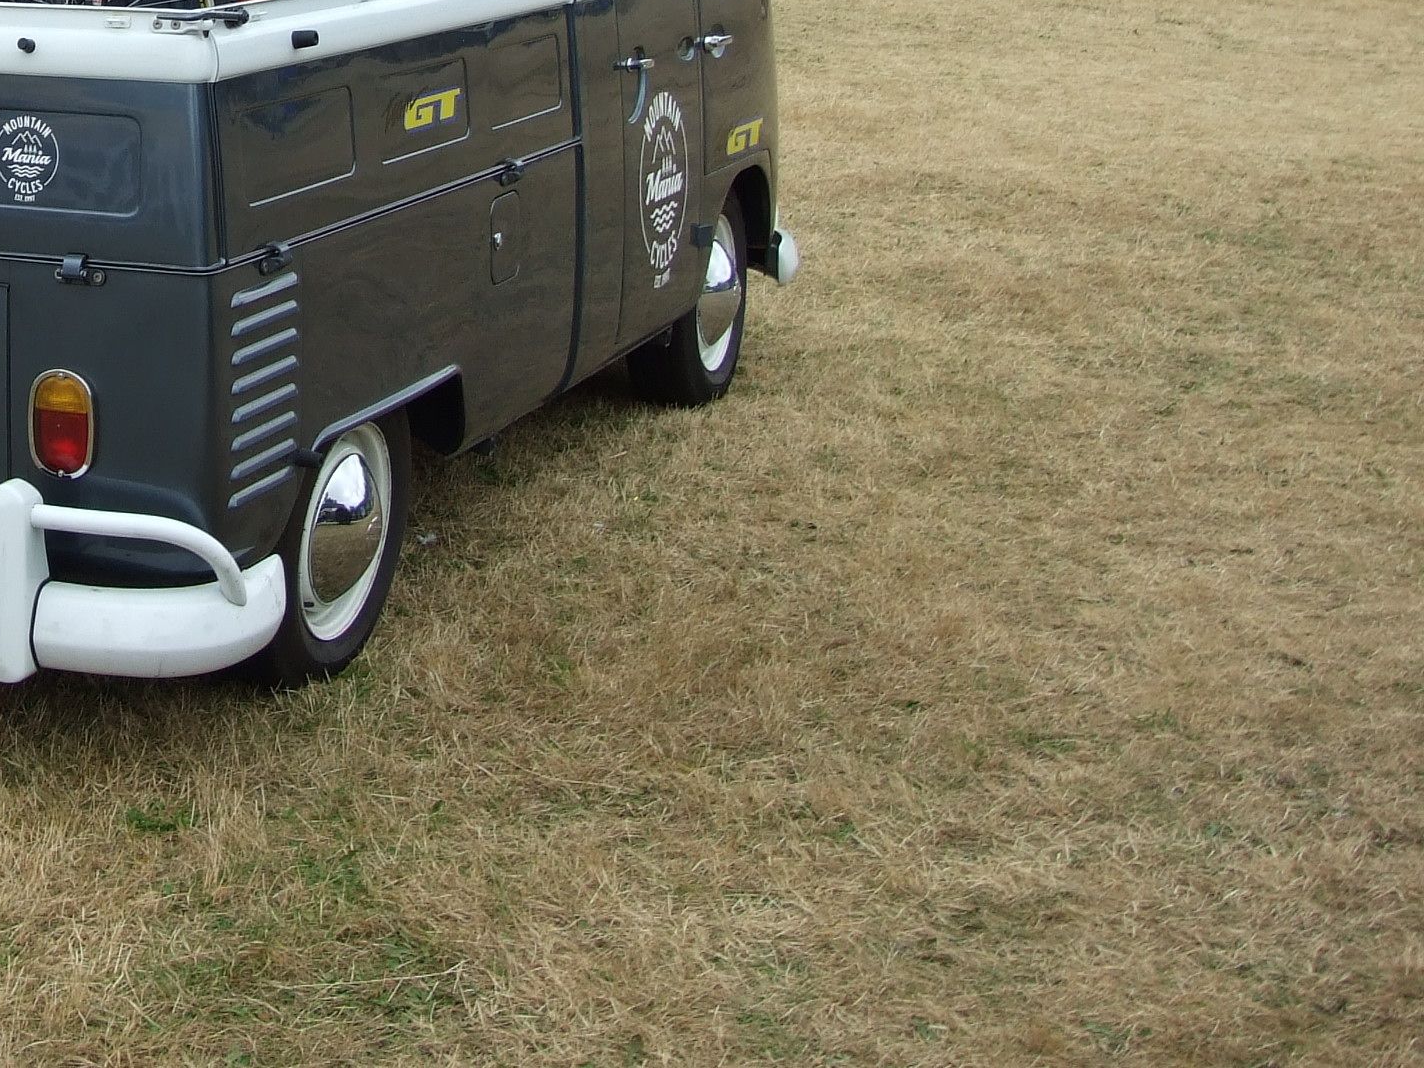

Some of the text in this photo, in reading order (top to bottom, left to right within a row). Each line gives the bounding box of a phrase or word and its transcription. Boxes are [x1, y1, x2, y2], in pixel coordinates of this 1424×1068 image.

[2, 116, 53, 138] MOUNTAIN
[404, 88, 462, 130] GT
[644, 91, 682, 142] MOUNTAIN
[1, 147, 52, 165] Mania
[725, 117, 764, 156] GT
[7, 178, 44, 194] CYCLES
[645, 164, 683, 206] Mania
[650, 230, 678, 270] CYCLES
